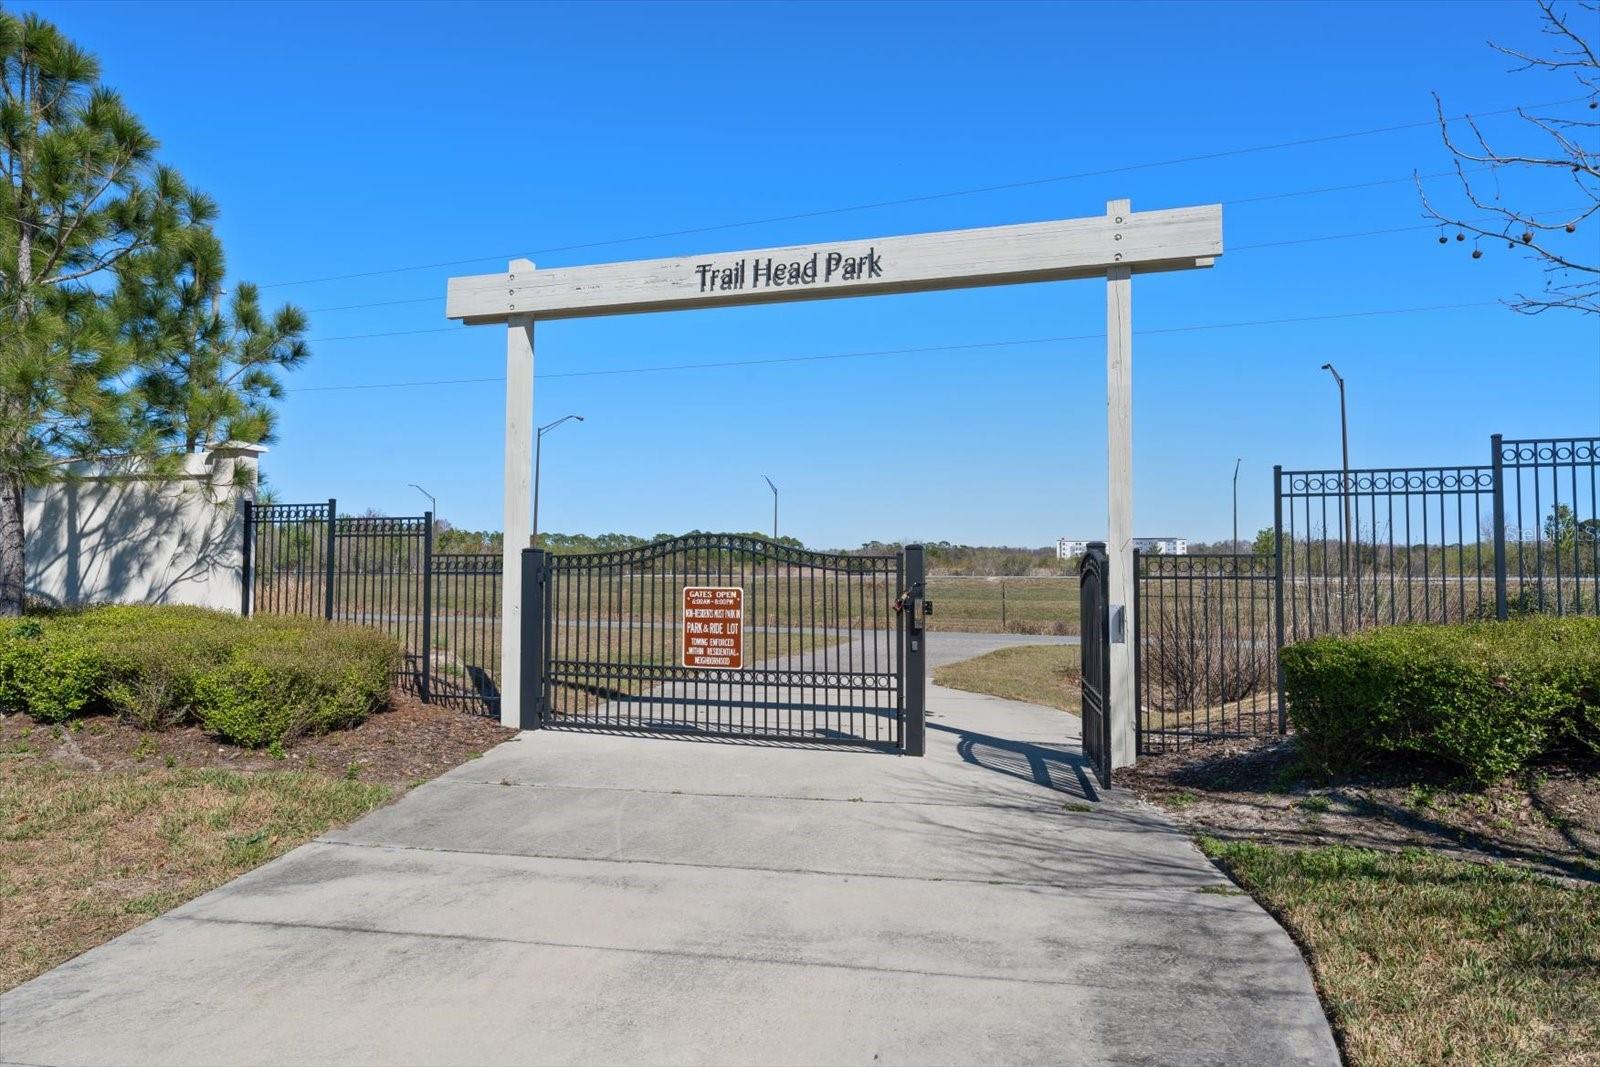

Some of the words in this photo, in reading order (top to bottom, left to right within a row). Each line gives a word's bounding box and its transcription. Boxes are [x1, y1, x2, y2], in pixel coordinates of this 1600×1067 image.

[696, 259, 745, 290] Trail
[754, 252, 817, 284] Head
[826, 247, 882, 279] Park
[686, 622, 703, 633] PARK
[703, 624, 709, 633] &
[709, 623, 724, 634] RIDE
[726, 623, 739, 635] LOT
[691, 638, 708, 646] TOWING
[709, 638, 735, 647] ENFORCED
[688, 647, 704, 655] WITHIN
[707, 647, 736, 656] RESIDENTIAL
[694, 656, 731, 665] NEIGHBORHOOD
